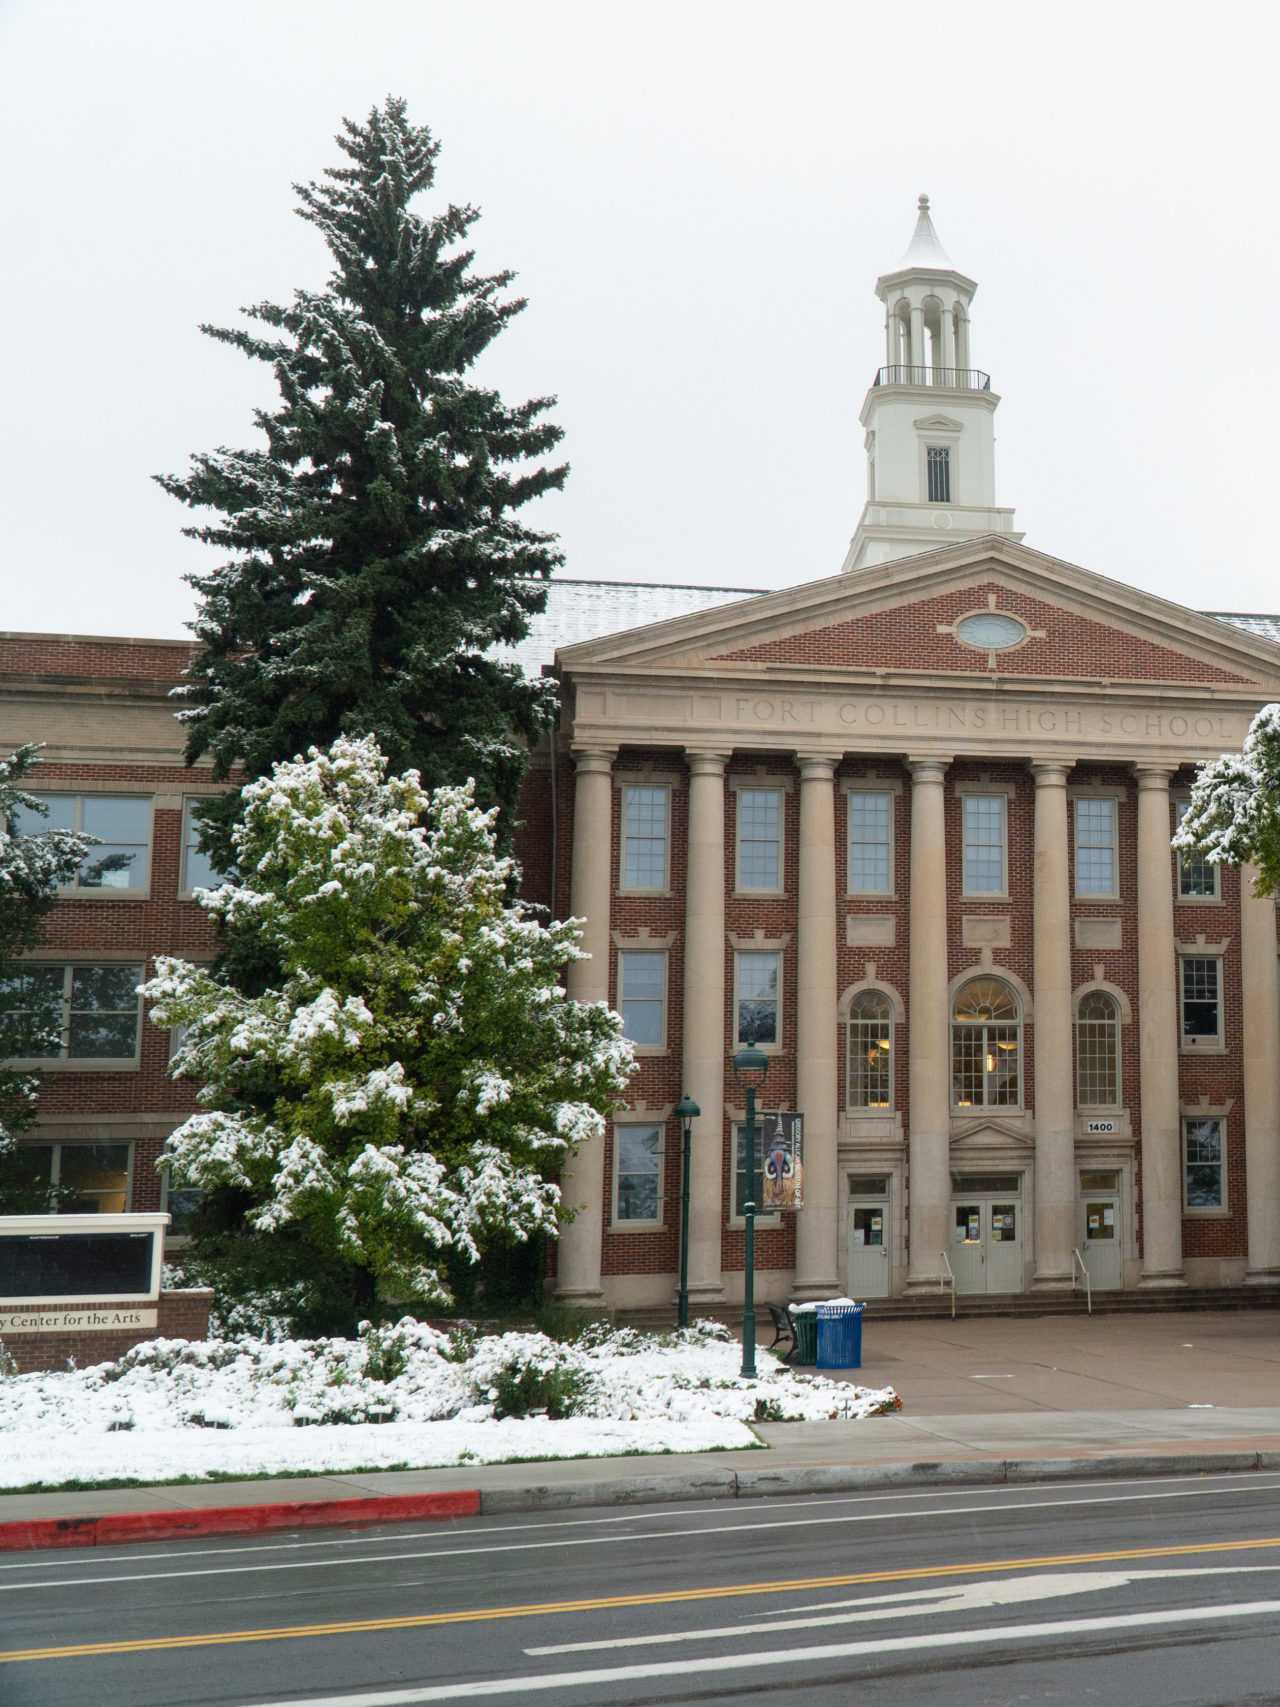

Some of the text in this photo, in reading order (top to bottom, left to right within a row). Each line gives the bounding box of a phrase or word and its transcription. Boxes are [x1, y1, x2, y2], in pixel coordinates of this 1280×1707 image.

[734, 699, 1233, 738] FORT COLLINS HIGH SCHOOL
[1089, 1123, 1113, 1131] 1400
[10, 1315, 59, 1326] Center
[63, 1313, 83, 1325] for
[87, 1313, 109, 1324] the
[111, 1313, 141, 1324] Arts
